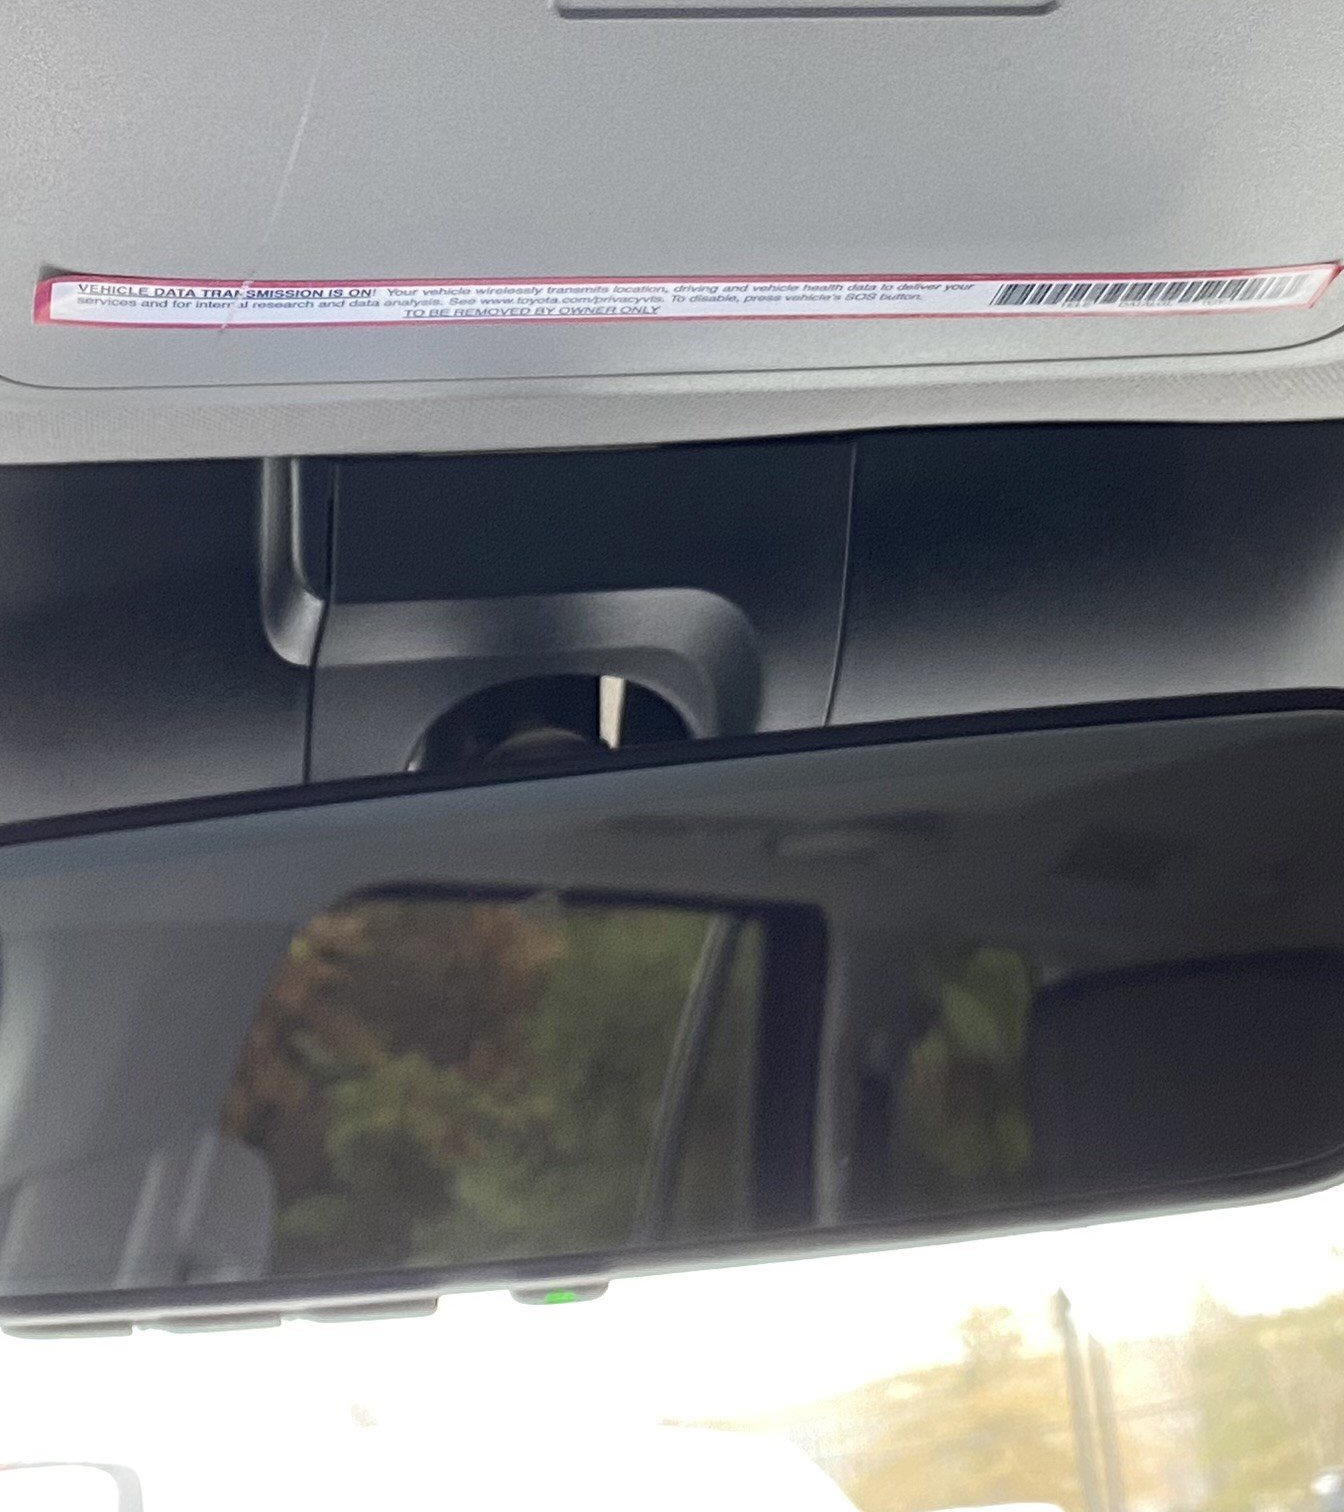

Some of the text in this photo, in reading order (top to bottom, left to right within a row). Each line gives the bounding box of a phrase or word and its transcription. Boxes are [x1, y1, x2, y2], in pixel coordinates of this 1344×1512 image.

[78, 284, 149, 296] VEHICLE
[154, 288, 196, 298] DATA
[328, 289, 344, 298] IS
[348, 289, 377, 298] ON!
[387, 288, 418, 297] Your
[422, 287, 471, 296] vehicle
[475, 286, 543, 296] wirelessly
[547, 286, 609, 294] transmits
[613, 285, 668, 294] location,
[673, 284, 719, 294] driving
[722, 284, 749, 292] and
[753, 283, 799, 292] vehicle
[803, 283, 843, 292] health
[847, 283, 877, 292] data
[880, 283, 894, 291] to
[897, 283, 942, 291] deliver
[944, 283, 975, 292] your
[77, 296, 137, 307] services
[141, 299, 169, 308] and
[172, 299, 192, 308] for
[252, 299, 314, 308] research
[319, 299, 346, 308] and
[349, 299, 380, 307] data
[384, 297, 443, 307] analysis.
[449, 297, 477, 306] See
[672, 294, 686, 303] To
[743, 294, 781, 303] press
[844, 293, 877, 301] SOS
[405, 306, 661, 318] TO BE REMOVED BY OWNER ONLY
